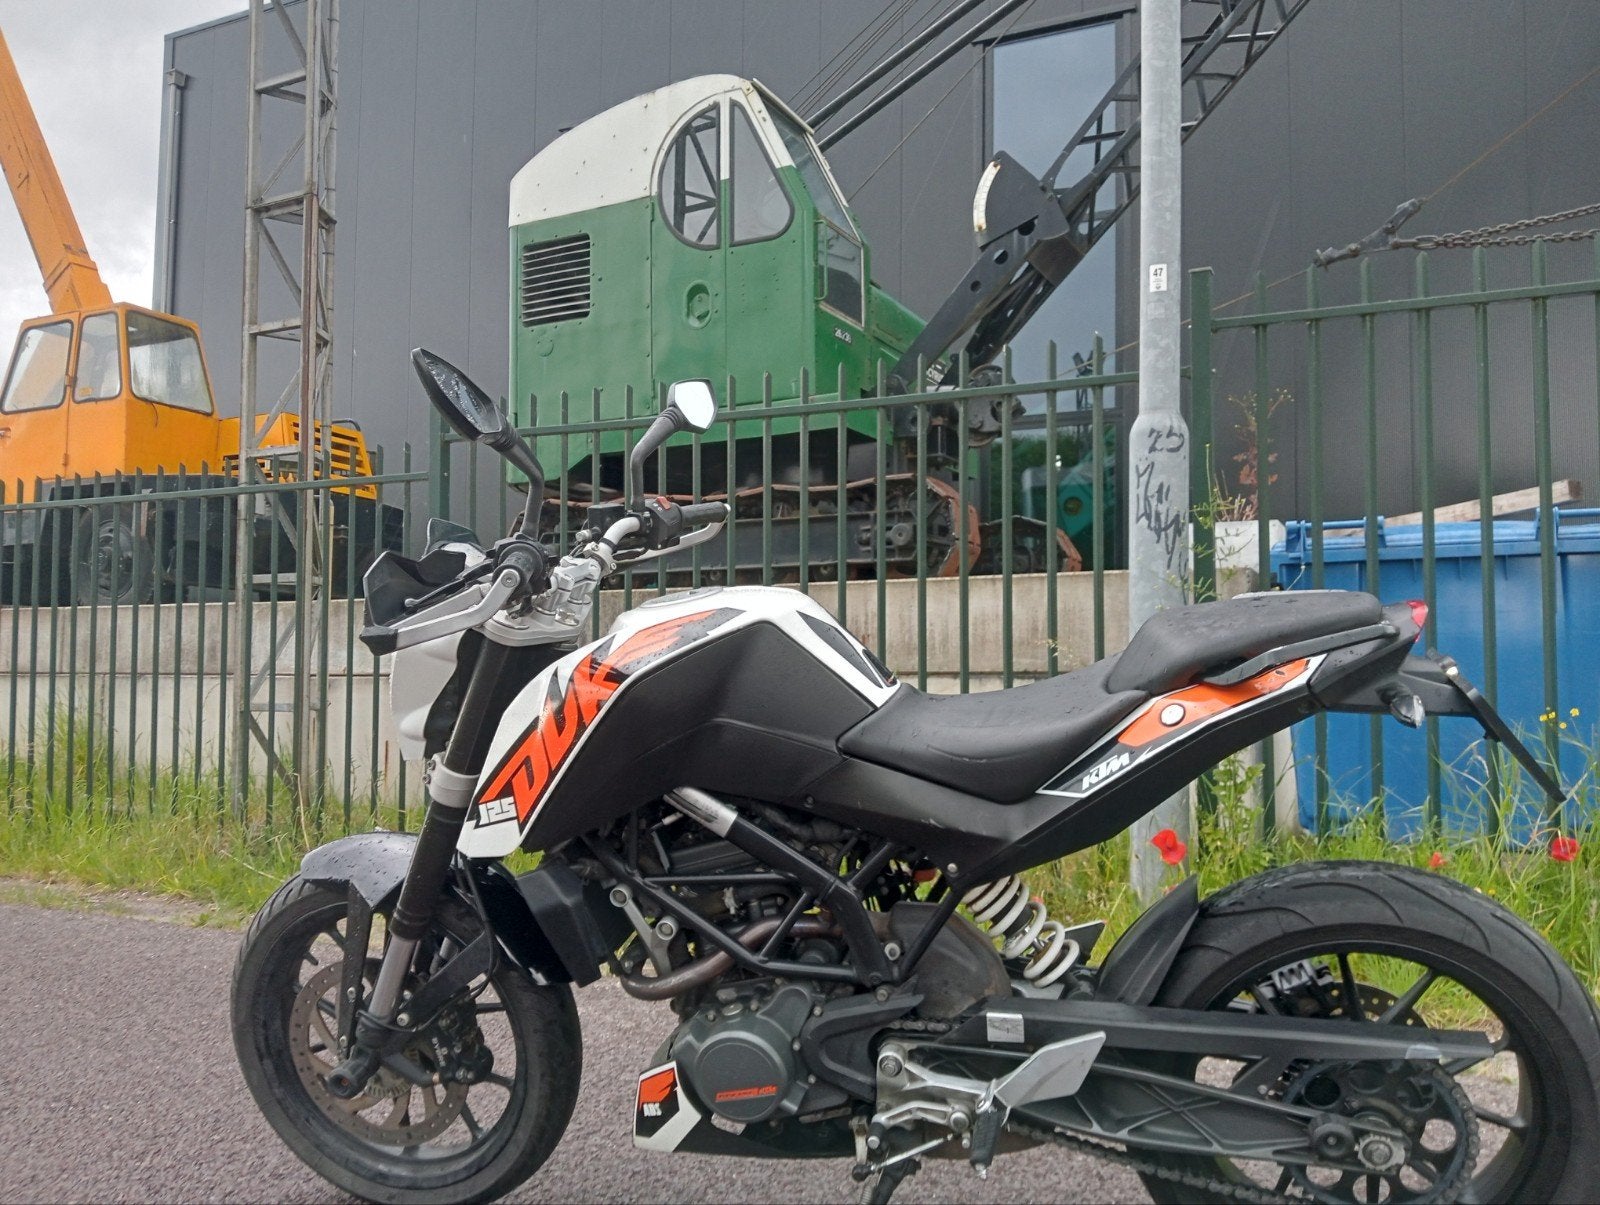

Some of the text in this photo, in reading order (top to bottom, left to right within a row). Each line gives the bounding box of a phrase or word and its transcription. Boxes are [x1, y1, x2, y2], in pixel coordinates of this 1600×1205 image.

[1153, 267, 1163, 277] 47
[1082, 752, 1129, 791] KTM
[479, 796, 517, 826] 125
